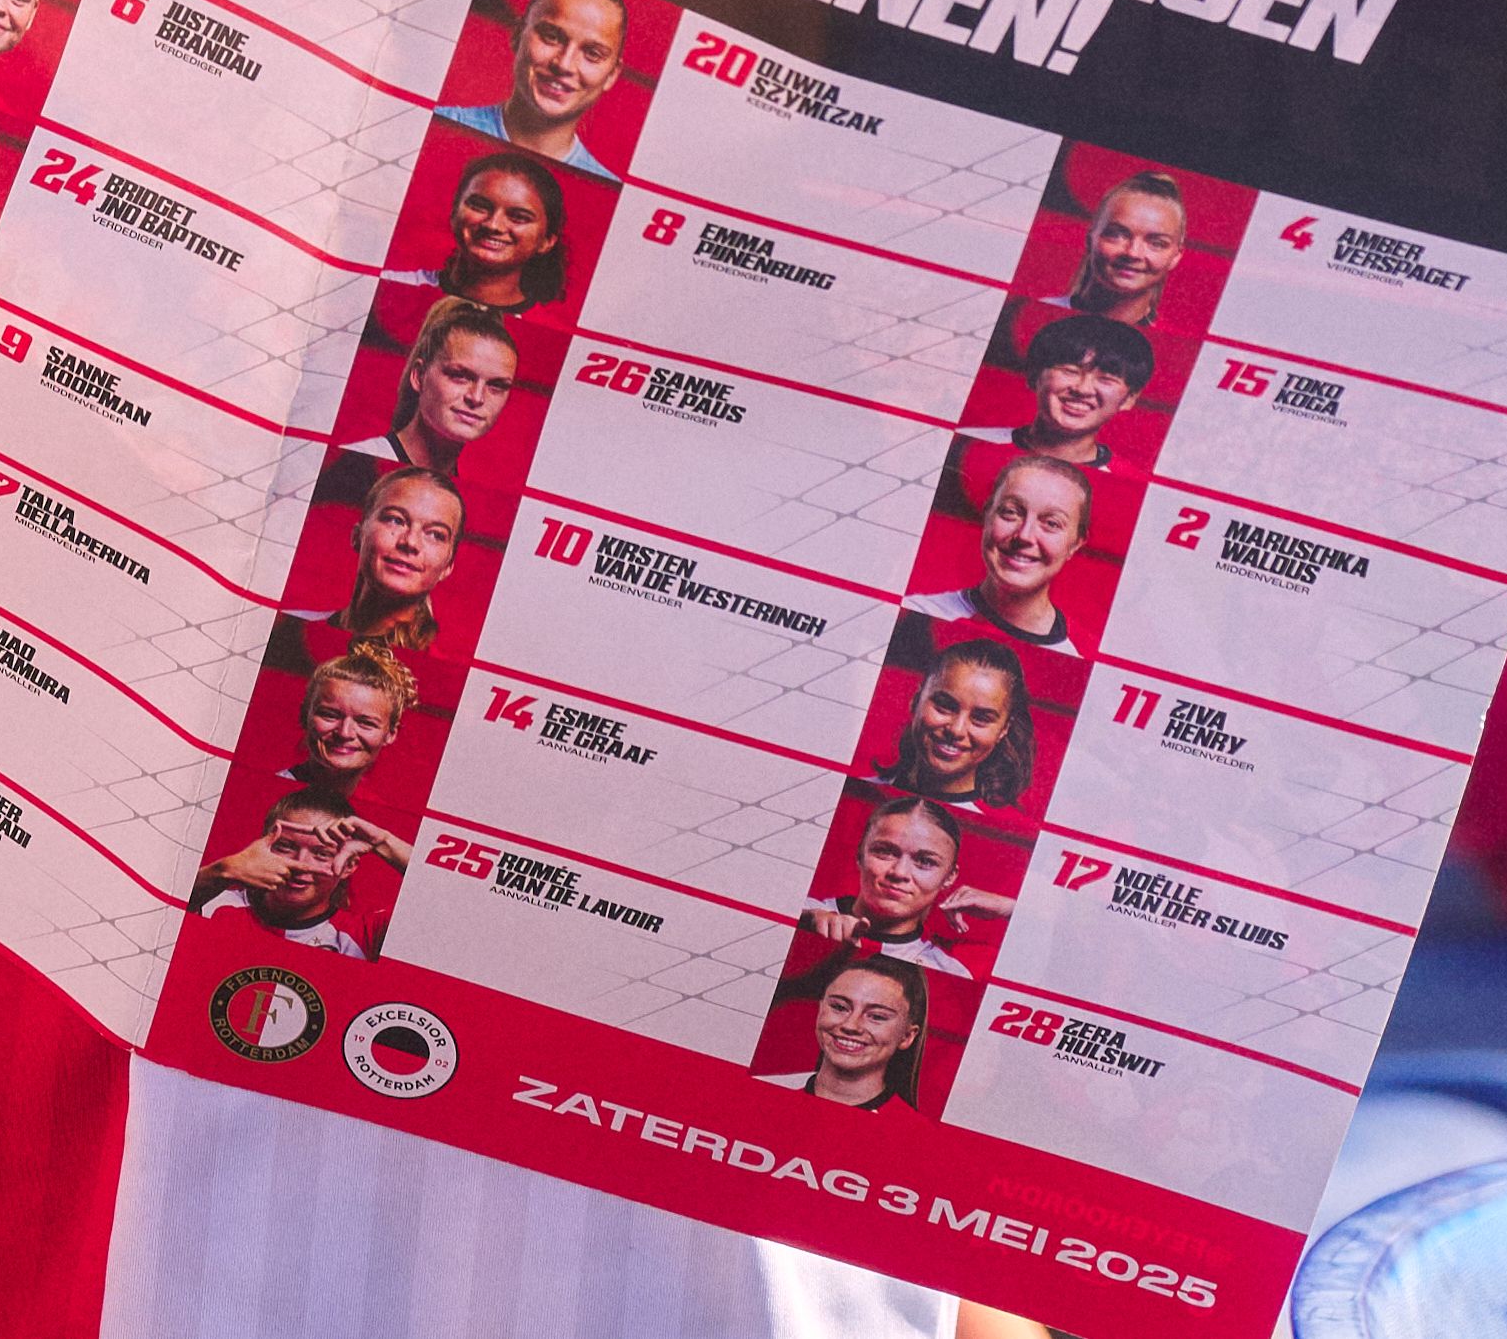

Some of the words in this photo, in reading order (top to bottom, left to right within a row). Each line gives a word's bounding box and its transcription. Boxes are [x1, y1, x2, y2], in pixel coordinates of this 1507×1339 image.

[163, 1, 249, 52] JUSTINE
[155, 40, 222, 78] VERDEDIGER
[156, 19, 262, 81] BRANDAU
[683, 31, 758, 88] 20
[757, 58, 840, 104] OLIWIA
[746, 96, 791, 120] KEEPER
[750, 77, 886, 135] SZYMCZAK
[30, 148, 104, 206] 24
[103, 173, 197, 225] BRIDGET
[93, 214, 163, 250] VERDEDIGER
[96, 194, 140, 226] JNO
[138, 213, 245, 272] BAPTISTE
[643, 209, 686, 246] 8
[700, 222, 775, 257] EMMA
[1280, 216, 1319, 251] 4
[1338, 227, 1426, 261] AMBER
[693, 257, 769, 284] VERDEDIGER
[1327, 262, 1404, 287] VERDEDIGER
[1334, 244, 1471, 291] VERSPAGET
[46, 346, 121, 392] SANNE
[575, 352, 651, 395] 26
[650, 367, 735, 401] SANNE
[1217, 359, 1277, 398] 15
[1282, 373, 1345, 399] TOKO
[40, 378, 123, 425] MIDDENVELDER
[42, 362, 151, 427] KOOPMAN
[642, 401, 718, 428] VERDEDIGER
[644, 384, 679, 406] DE
[678, 393, 746, 424] PAUS
[1274, 389, 1339, 416] KOGA
[1272, 404, 1347, 427] VERDEDIGER
[21, 484, 75, 525] TALIA
[15, 515, 95, 563] MIDDENVELDER
[16, 501, 150, 585] DELLAPERUTA
[535, 517, 593, 567] 10
[1165, 507, 1210, 550] 2
[1224, 519, 1370, 579] MARUSCHKA
[596, 534, 698, 578] KIRSTEN
[1221, 540, 1321, 585] WALDUS
[588, 576, 682, 609] MIDDENVELDER
[593, 555, 645, 585] VAN
[642, 569, 676, 594] DE
[676, 578, 827, 637] WESTERINGH
[1215, 562, 1310, 595] MIDDENVELDER
[484, 686, 538, 731] 14
[545, 703, 627, 740] ESMEE
[1113, 684, 1162, 730] 11
[1169, 699, 1227, 731] ZIVA
[537, 738, 607, 764] AANVALLER
[540, 721, 574, 743] DE
[574, 731, 657, 765] GRAAF
[1161, 740, 1254, 772] MIDDENVELDER
[1163, 719, 1248, 755] HENRY
[425, 834, 501, 880] 25
[497, 852, 582, 889] ROMÉE
[1053, 849, 1113, 892] 17
[490, 886, 559, 912] AANVALLER
[495, 869, 546, 897] VAN
[544, 885, 579, 906] DE
[577, 895, 664, 933] LAVOIR
[1114, 866, 1203, 906] NOËLLE
[1107, 904, 1176, 929] AANVALLER
[1111, 886, 1162, 914] VAN
[1162, 902, 1211, 928] DER
[225, 969, 321, 1014] FEYENOORD
[215, 1018, 310, 1060] ROTTERDAM
[354, 1034, 365, 1043] 19
[366, 1011, 446, 1048] EXCELSIOR
[989, 1002, 1064, 1046] 28
[1061, 1018, 1126, 1050] ZERA
[355, 1055, 434, 1091] ROTTERDAM
[435, 1059, 448, 1068] 02
[1053, 1052, 1123, 1077] AANVALLER
[1056, 1035, 1165, 1078] HULSWIT
[512, 1075, 870, 1202] ZATERDAG
[878, 1184, 920, 1215] 3
[928, 1196, 1049, 1256] MEI
[1055, 1237, 1218, 1308] 2025
